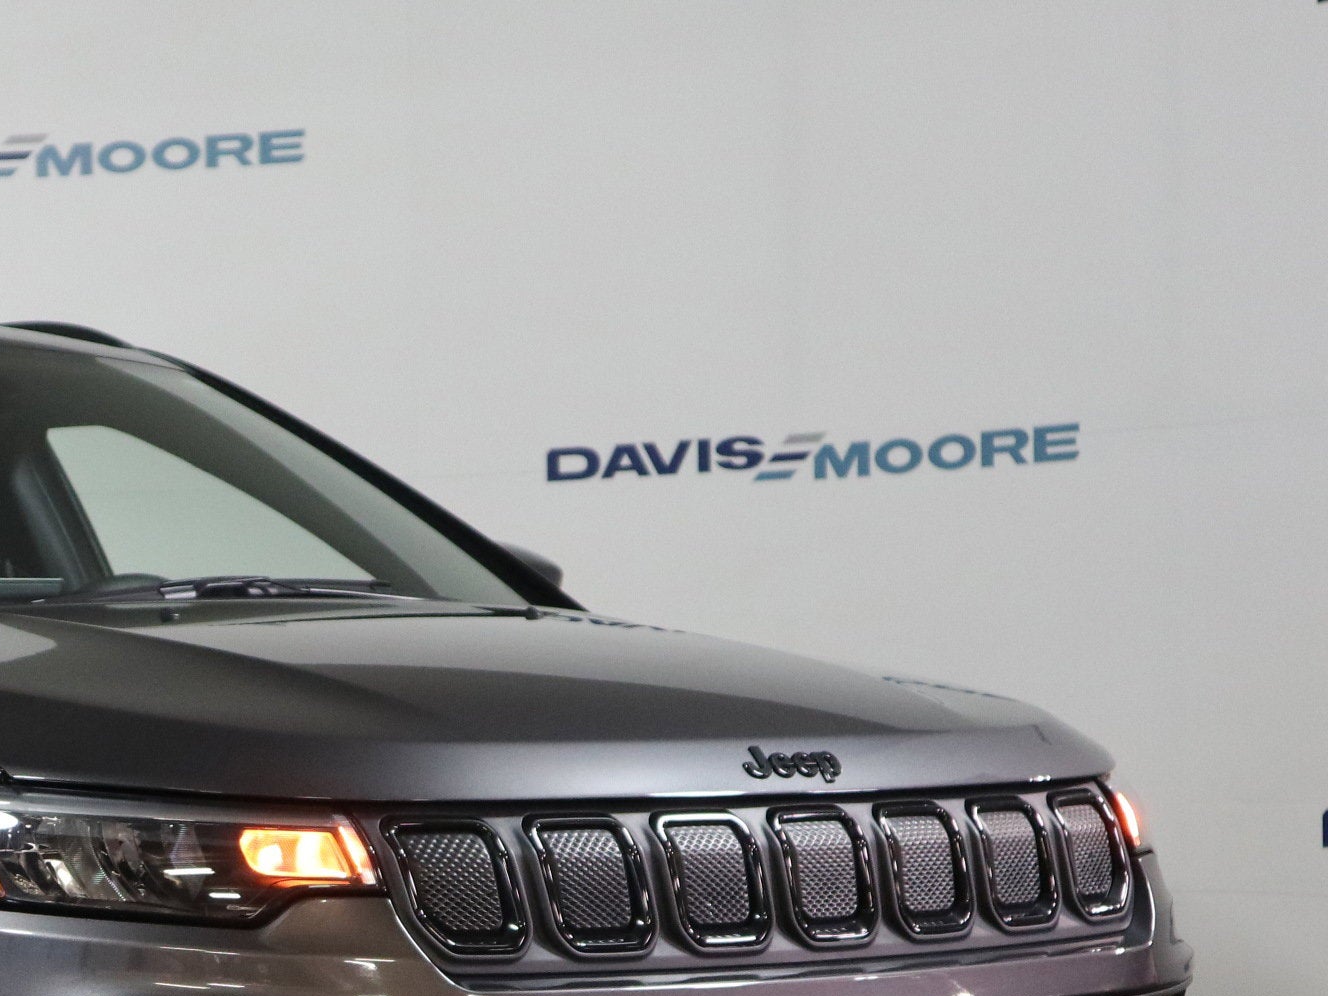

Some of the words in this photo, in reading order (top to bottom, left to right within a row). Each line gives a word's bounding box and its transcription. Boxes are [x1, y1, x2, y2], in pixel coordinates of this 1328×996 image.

[35, 129, 306, 177] MOORE
[545, 435, 768, 482] DAVIS
[813, 422, 1081, 480] MOORE
[742, 745, 842, 784] Jeep
